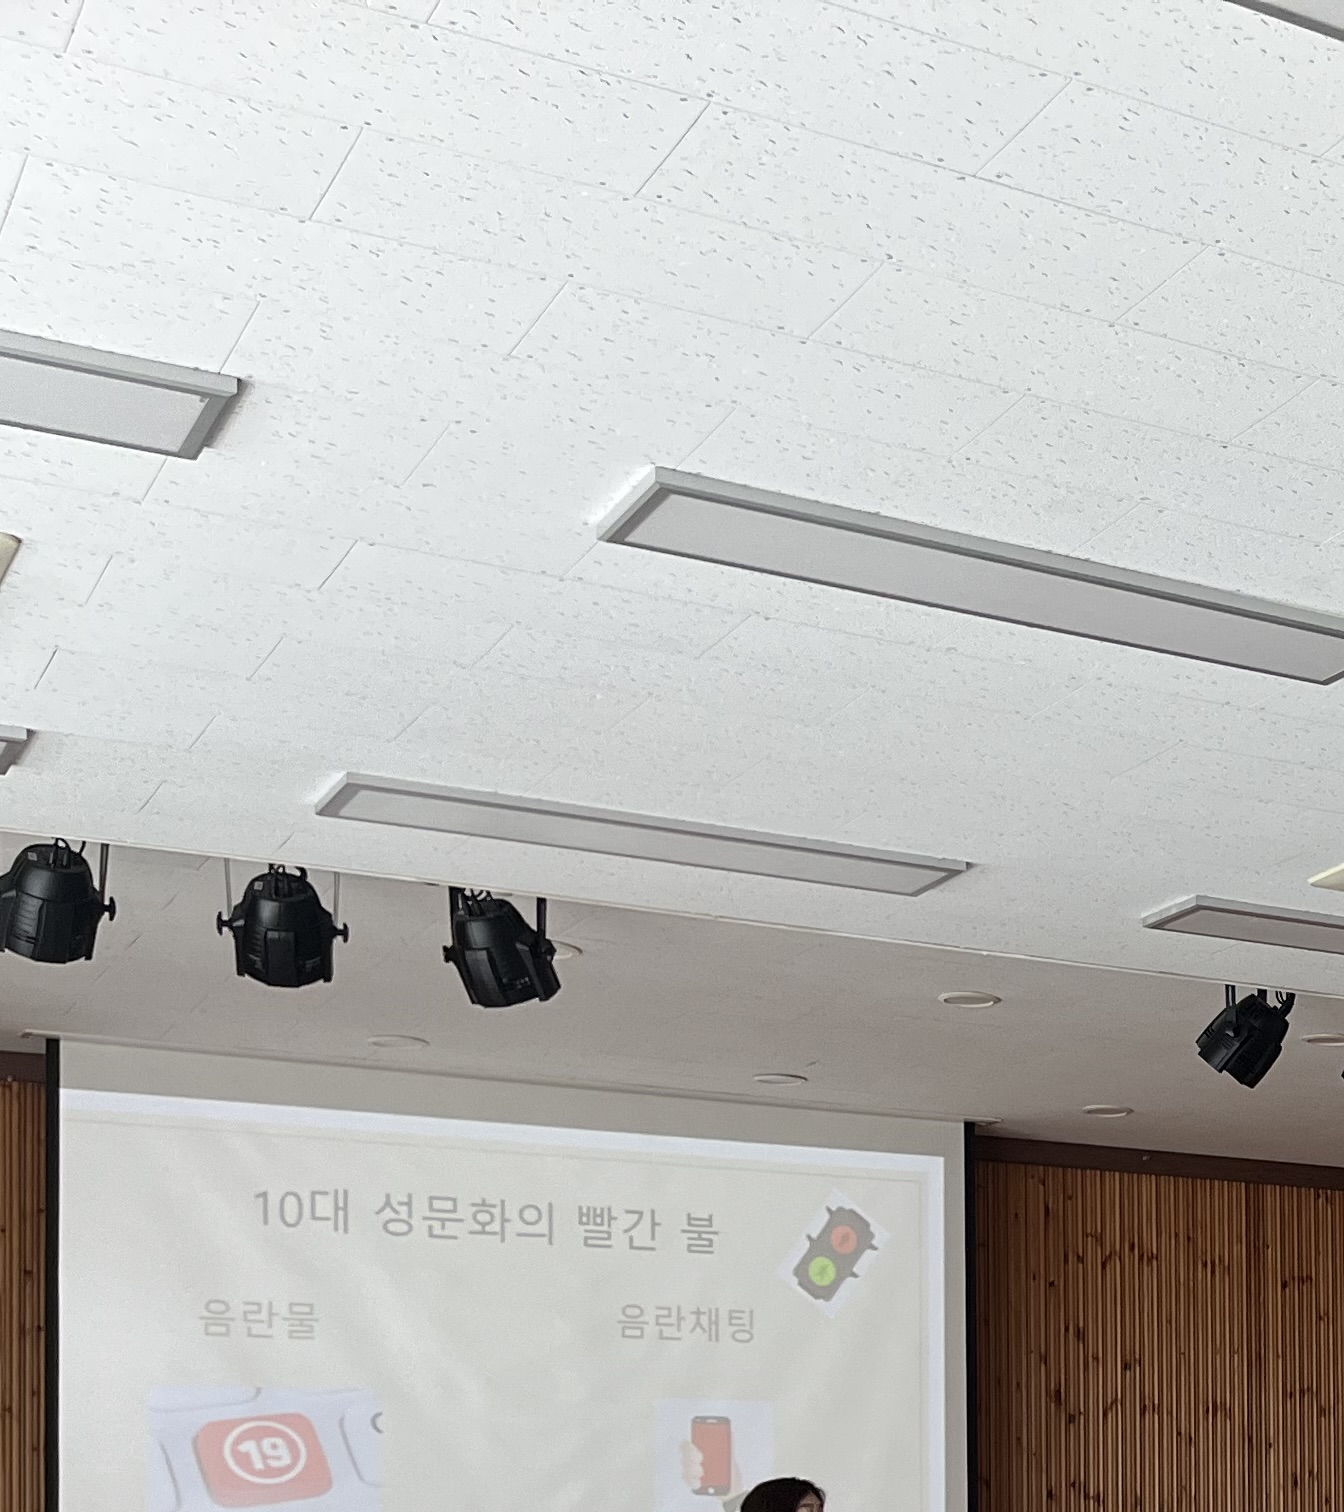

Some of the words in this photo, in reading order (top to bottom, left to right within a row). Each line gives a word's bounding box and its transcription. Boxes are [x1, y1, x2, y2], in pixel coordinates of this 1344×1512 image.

[253, 1188, 350, 1235] 10대
[374, 1192, 554, 1247] 성문화의
[577, 1204, 662, 1252] 빨간
[679, 1211, 720, 1255] 불
[198, 1299, 320, 1341] 음란물
[616, 1303, 755, 1344] 음란채팅
[237, 1436, 293, 1471] 19
